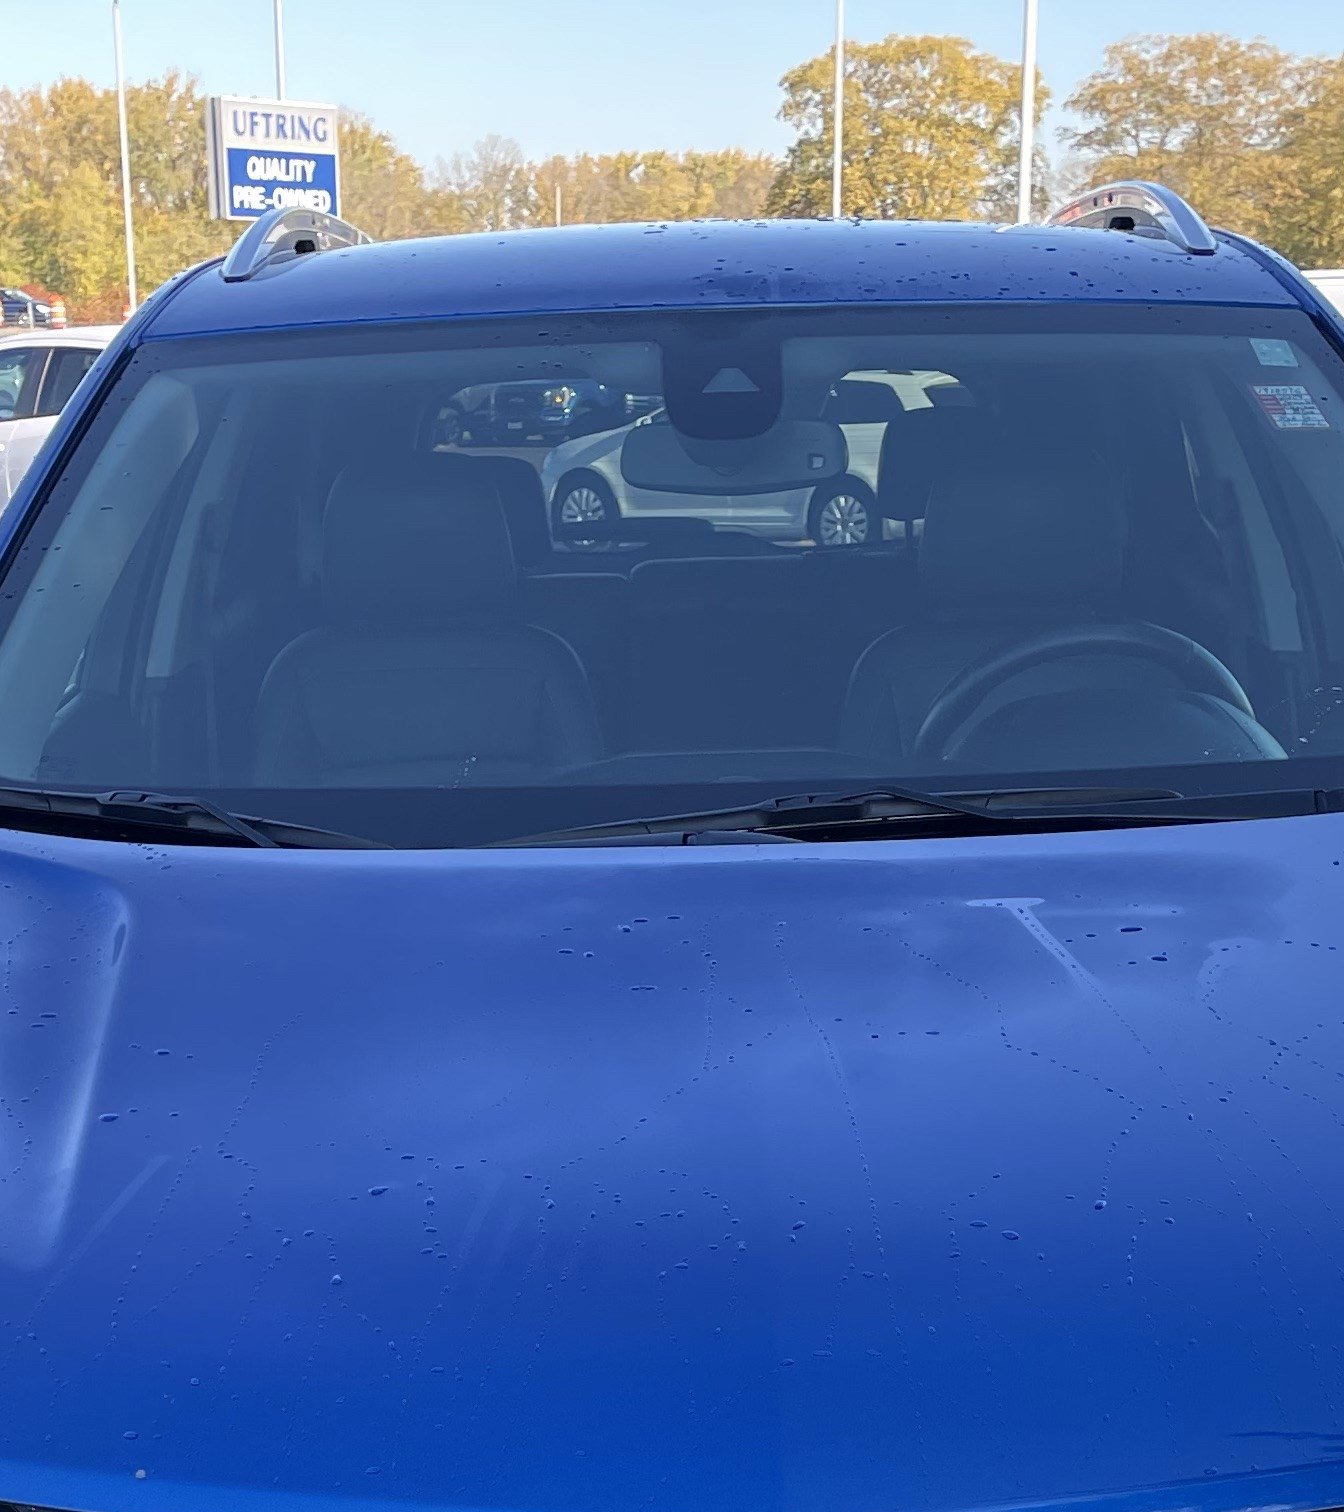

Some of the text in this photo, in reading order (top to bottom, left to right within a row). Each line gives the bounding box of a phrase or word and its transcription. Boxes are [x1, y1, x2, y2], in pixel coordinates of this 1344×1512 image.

[233, 110, 327, 142] UFTRING
[246, 156, 316, 182] QUALITY
[232, 185, 331, 213] PRE-OWNED
